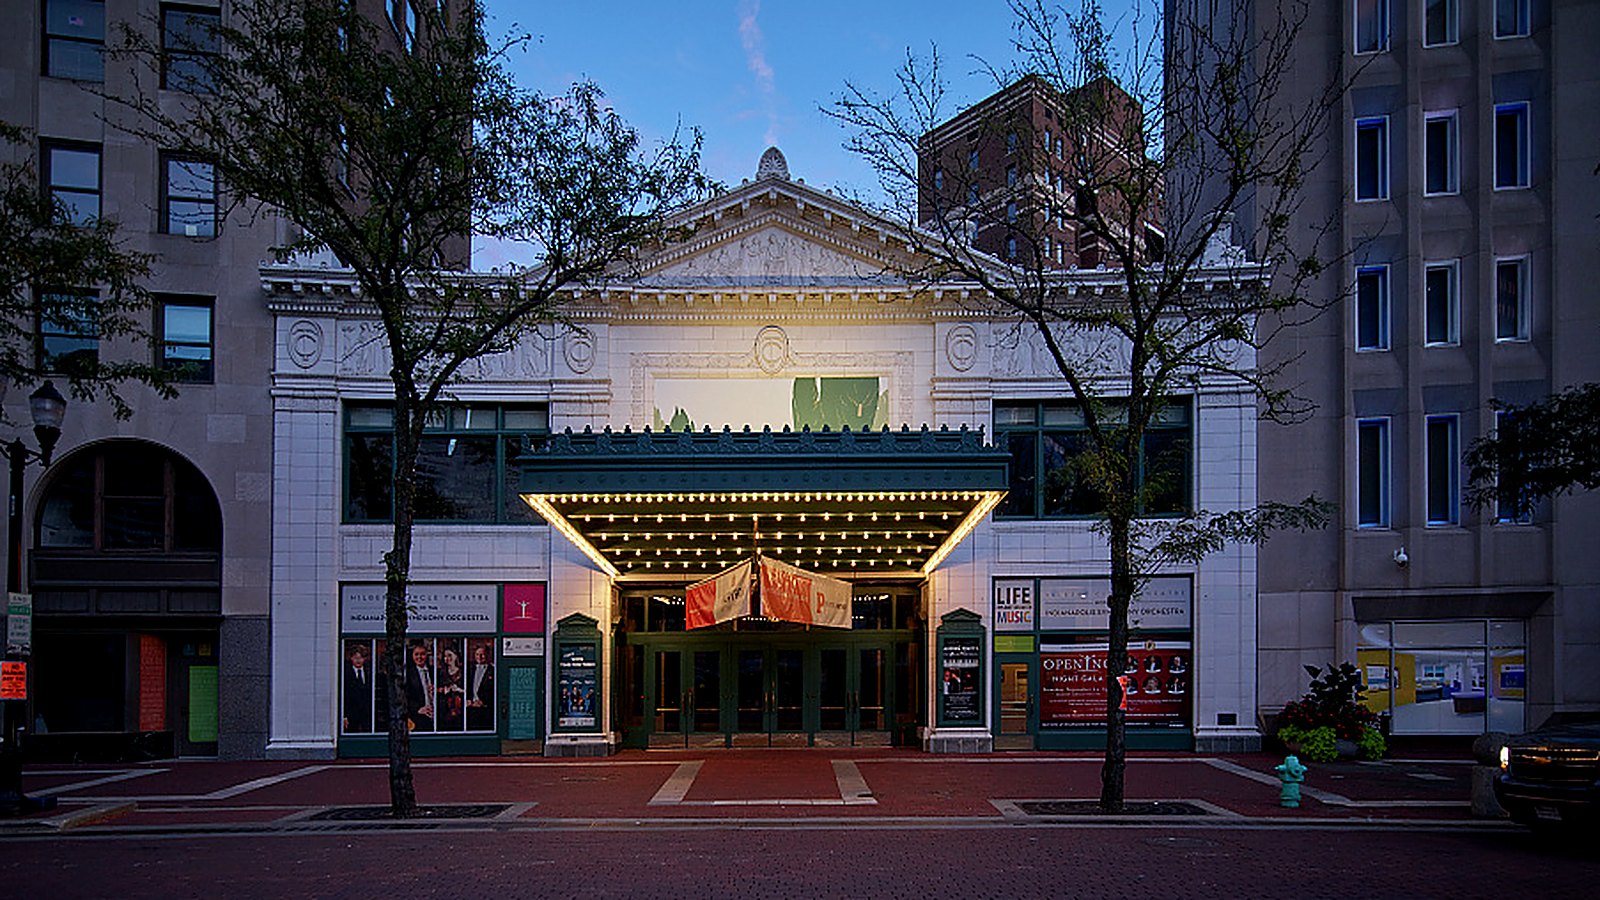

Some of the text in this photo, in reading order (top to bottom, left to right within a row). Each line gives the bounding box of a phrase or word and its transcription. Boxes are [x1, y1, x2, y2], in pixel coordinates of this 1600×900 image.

[350, 594, 386, 602] HILBE
[445, 594, 488, 602] THEATRE
[997, 587, 1031, 604] LIFE
[997, 611, 1031, 623] MUSIC
[1081, 674, 1103, 682] GALA
